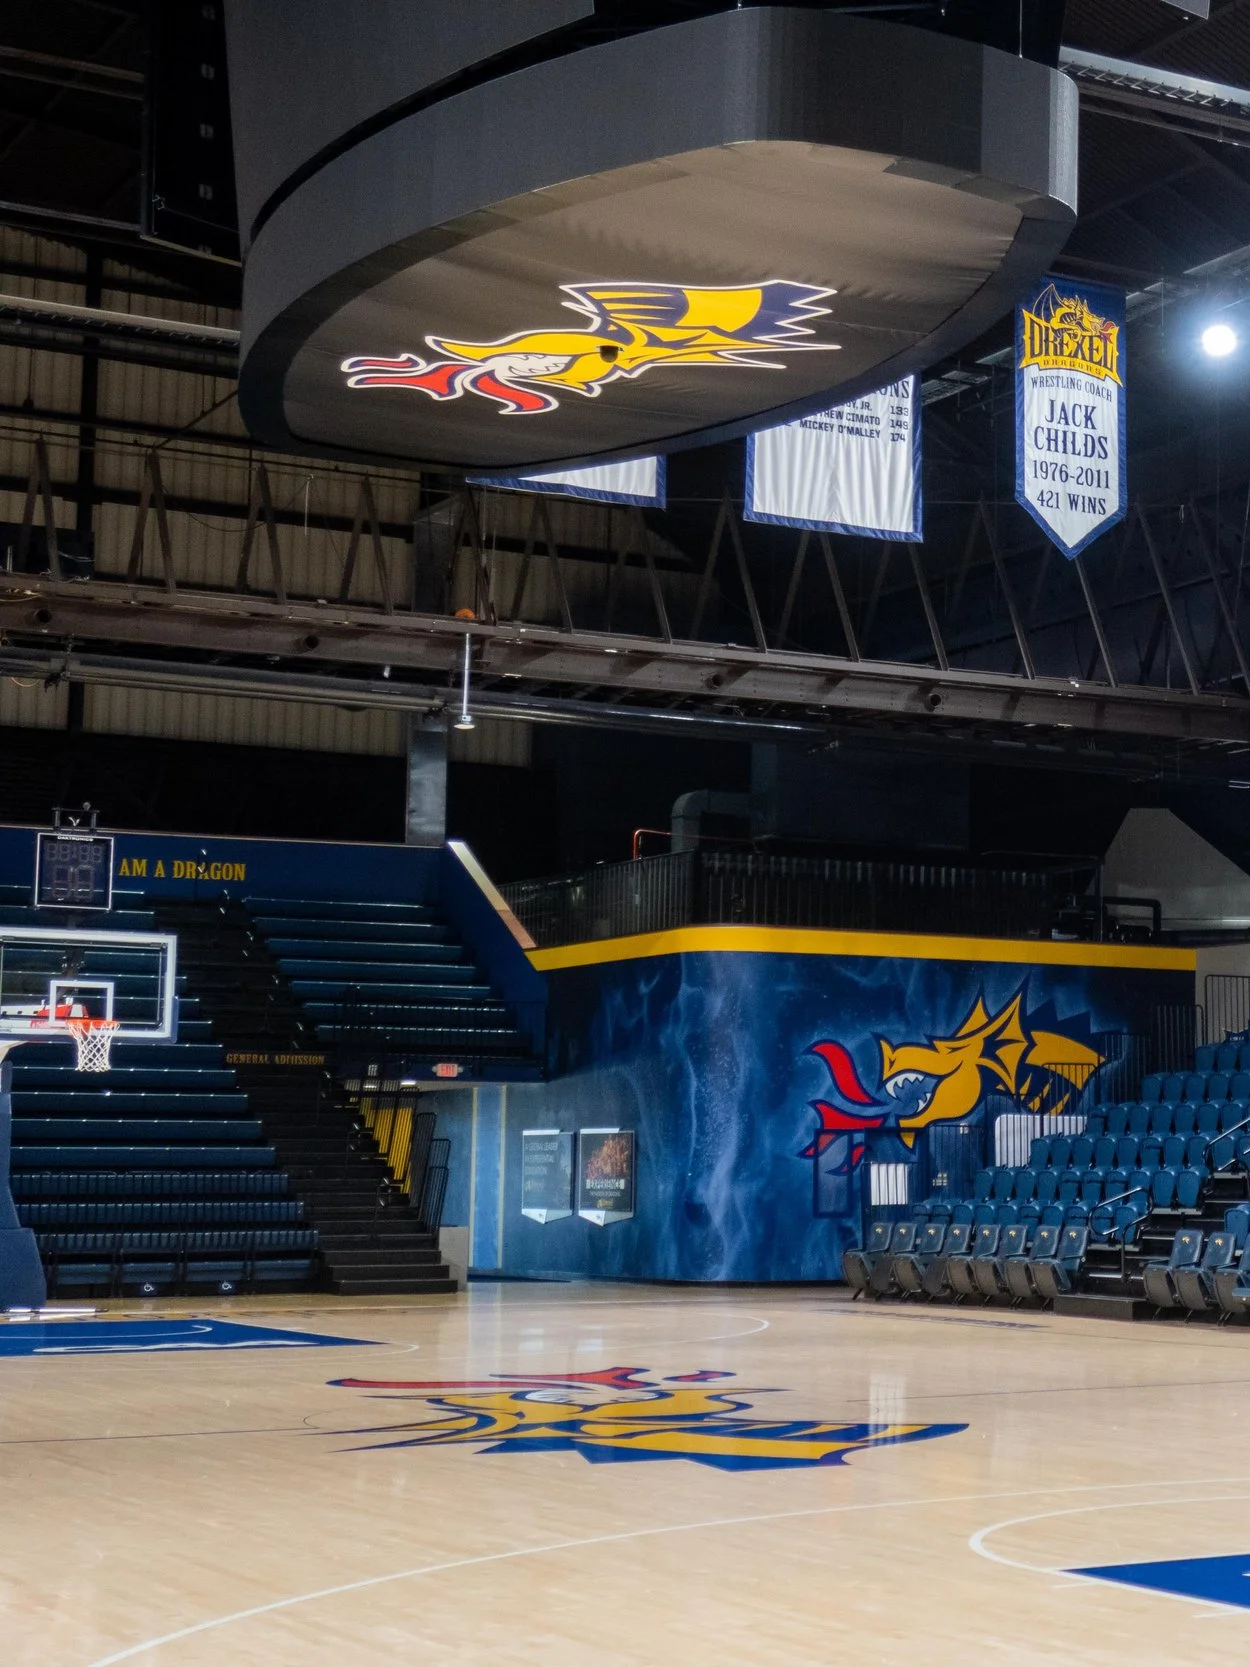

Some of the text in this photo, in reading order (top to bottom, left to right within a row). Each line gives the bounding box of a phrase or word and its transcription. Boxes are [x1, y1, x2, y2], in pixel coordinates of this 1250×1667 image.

[1029, 316, 1114, 373] DREXEL
[1031, 375, 1112, 402] WRESTLING COACH
[845, 411, 881, 426] CIMATO
[890, 405, 909, 417] 133
[1044, 398, 1097, 430] JACK
[799, 419, 834, 433] MICKEY
[890, 432, 906, 443] 174
[1034, 426, 1109, 460] CHILDS
[1033, 460, 1110, 489] 1976-2011
[1037, 489, 1106, 516] 421 WINS
[119, 858, 246, 881] AM A DRAGON
[226, 1053, 270, 1065] GENERAL
